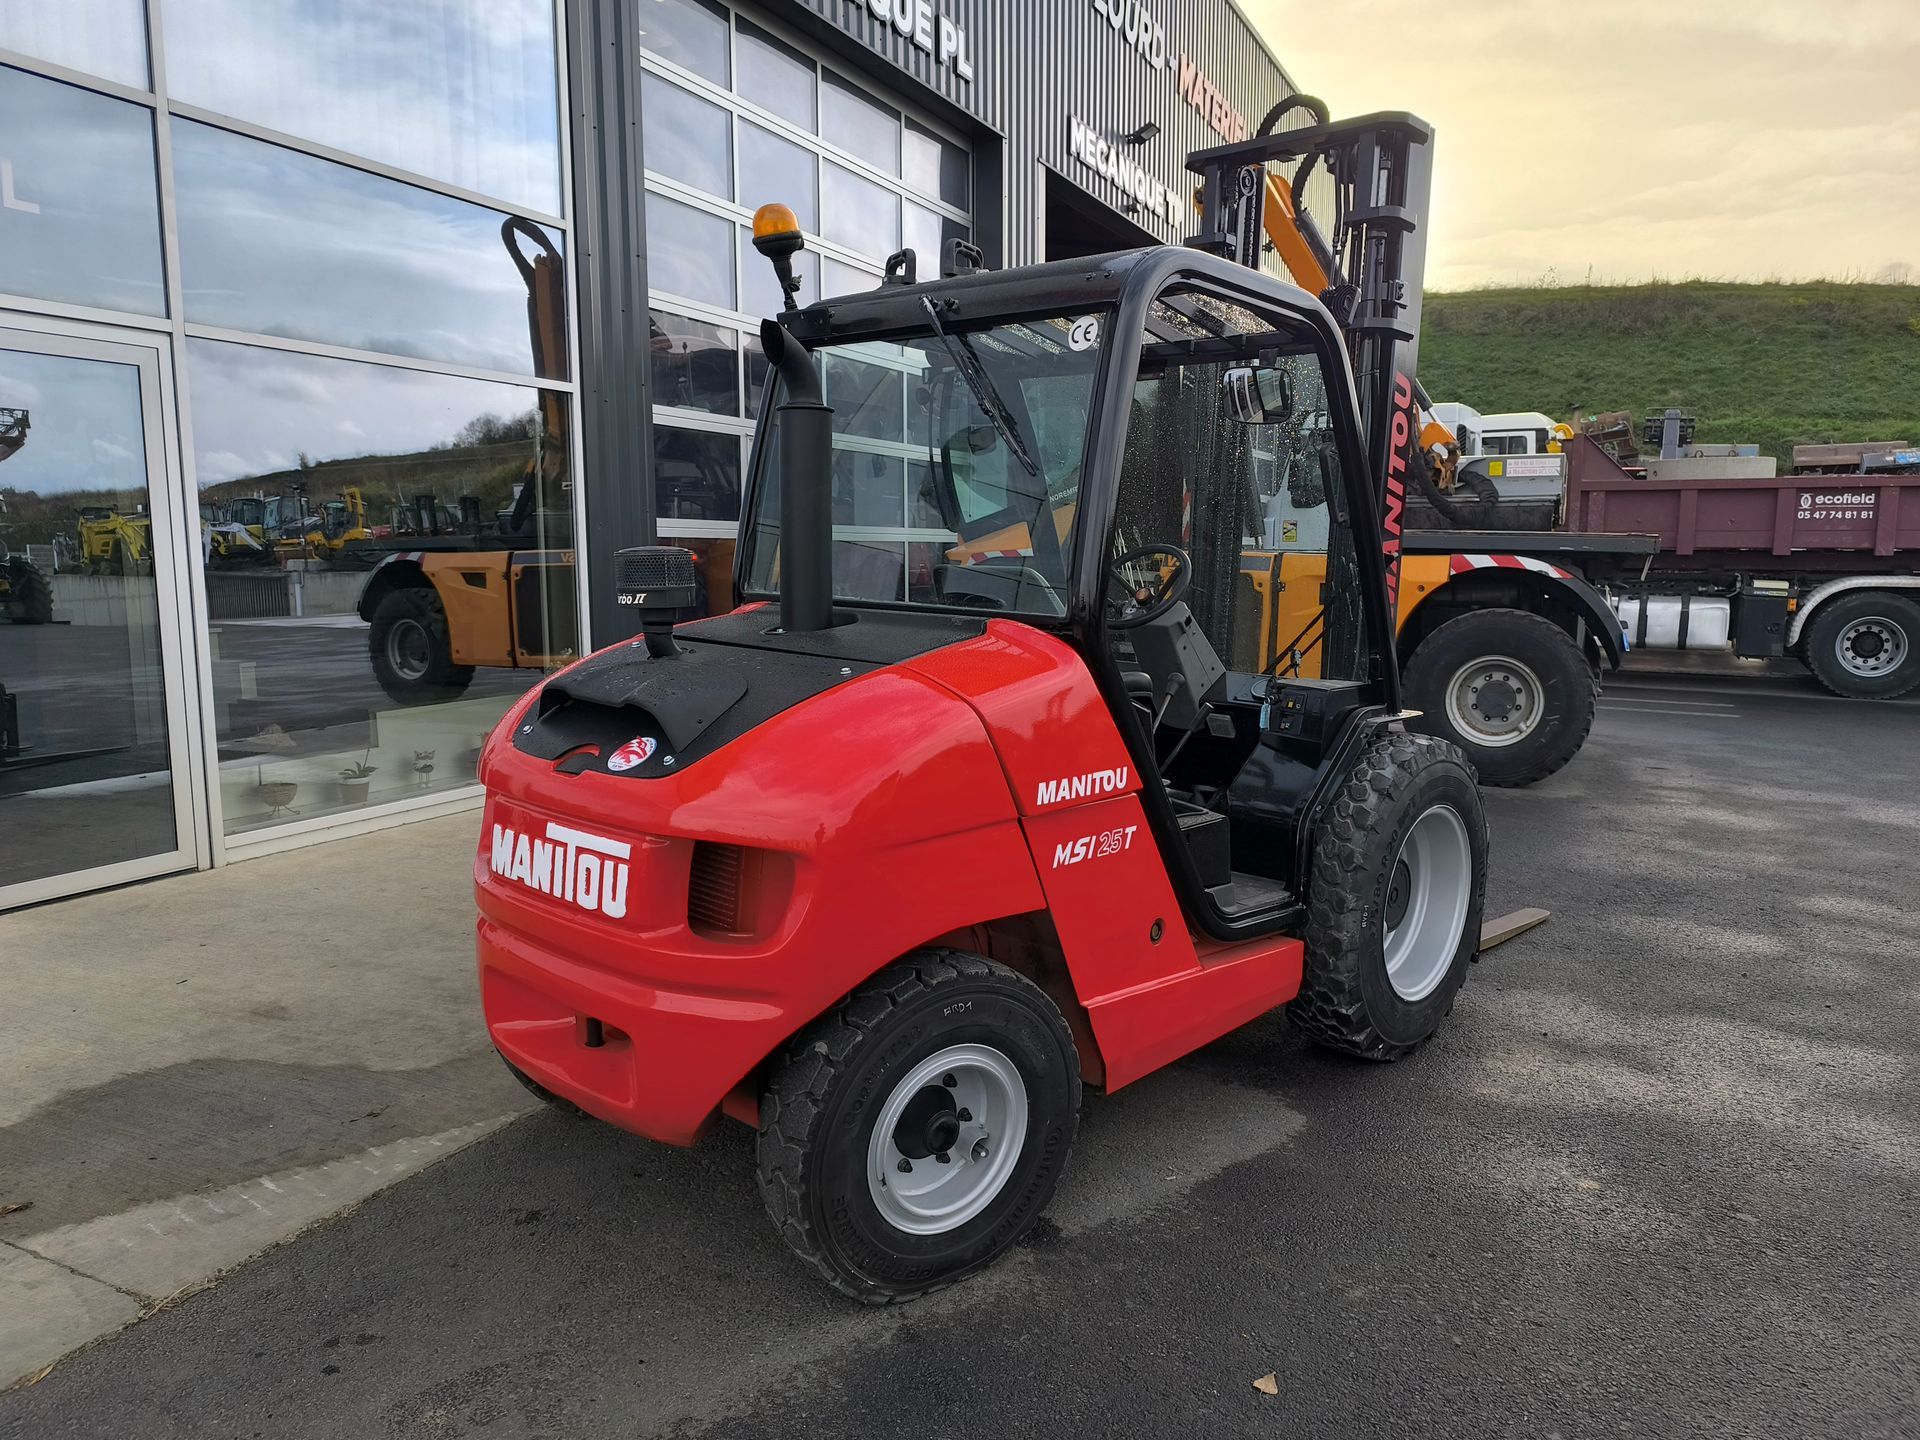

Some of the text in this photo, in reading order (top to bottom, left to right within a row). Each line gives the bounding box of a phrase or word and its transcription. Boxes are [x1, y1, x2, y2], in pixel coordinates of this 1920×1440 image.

[940, 14, 973, 81] PL
[1070, 115, 1166, 222] MECANIQUE
[1797, 510, 1874, 520] 05 47 74 81 81
[1815, 493, 1875, 505] ecofield
[1036, 766, 1128, 806] MANITOU
[491, 822, 632, 919] MANITOU
[1052, 835, 1097, 869] MSI
